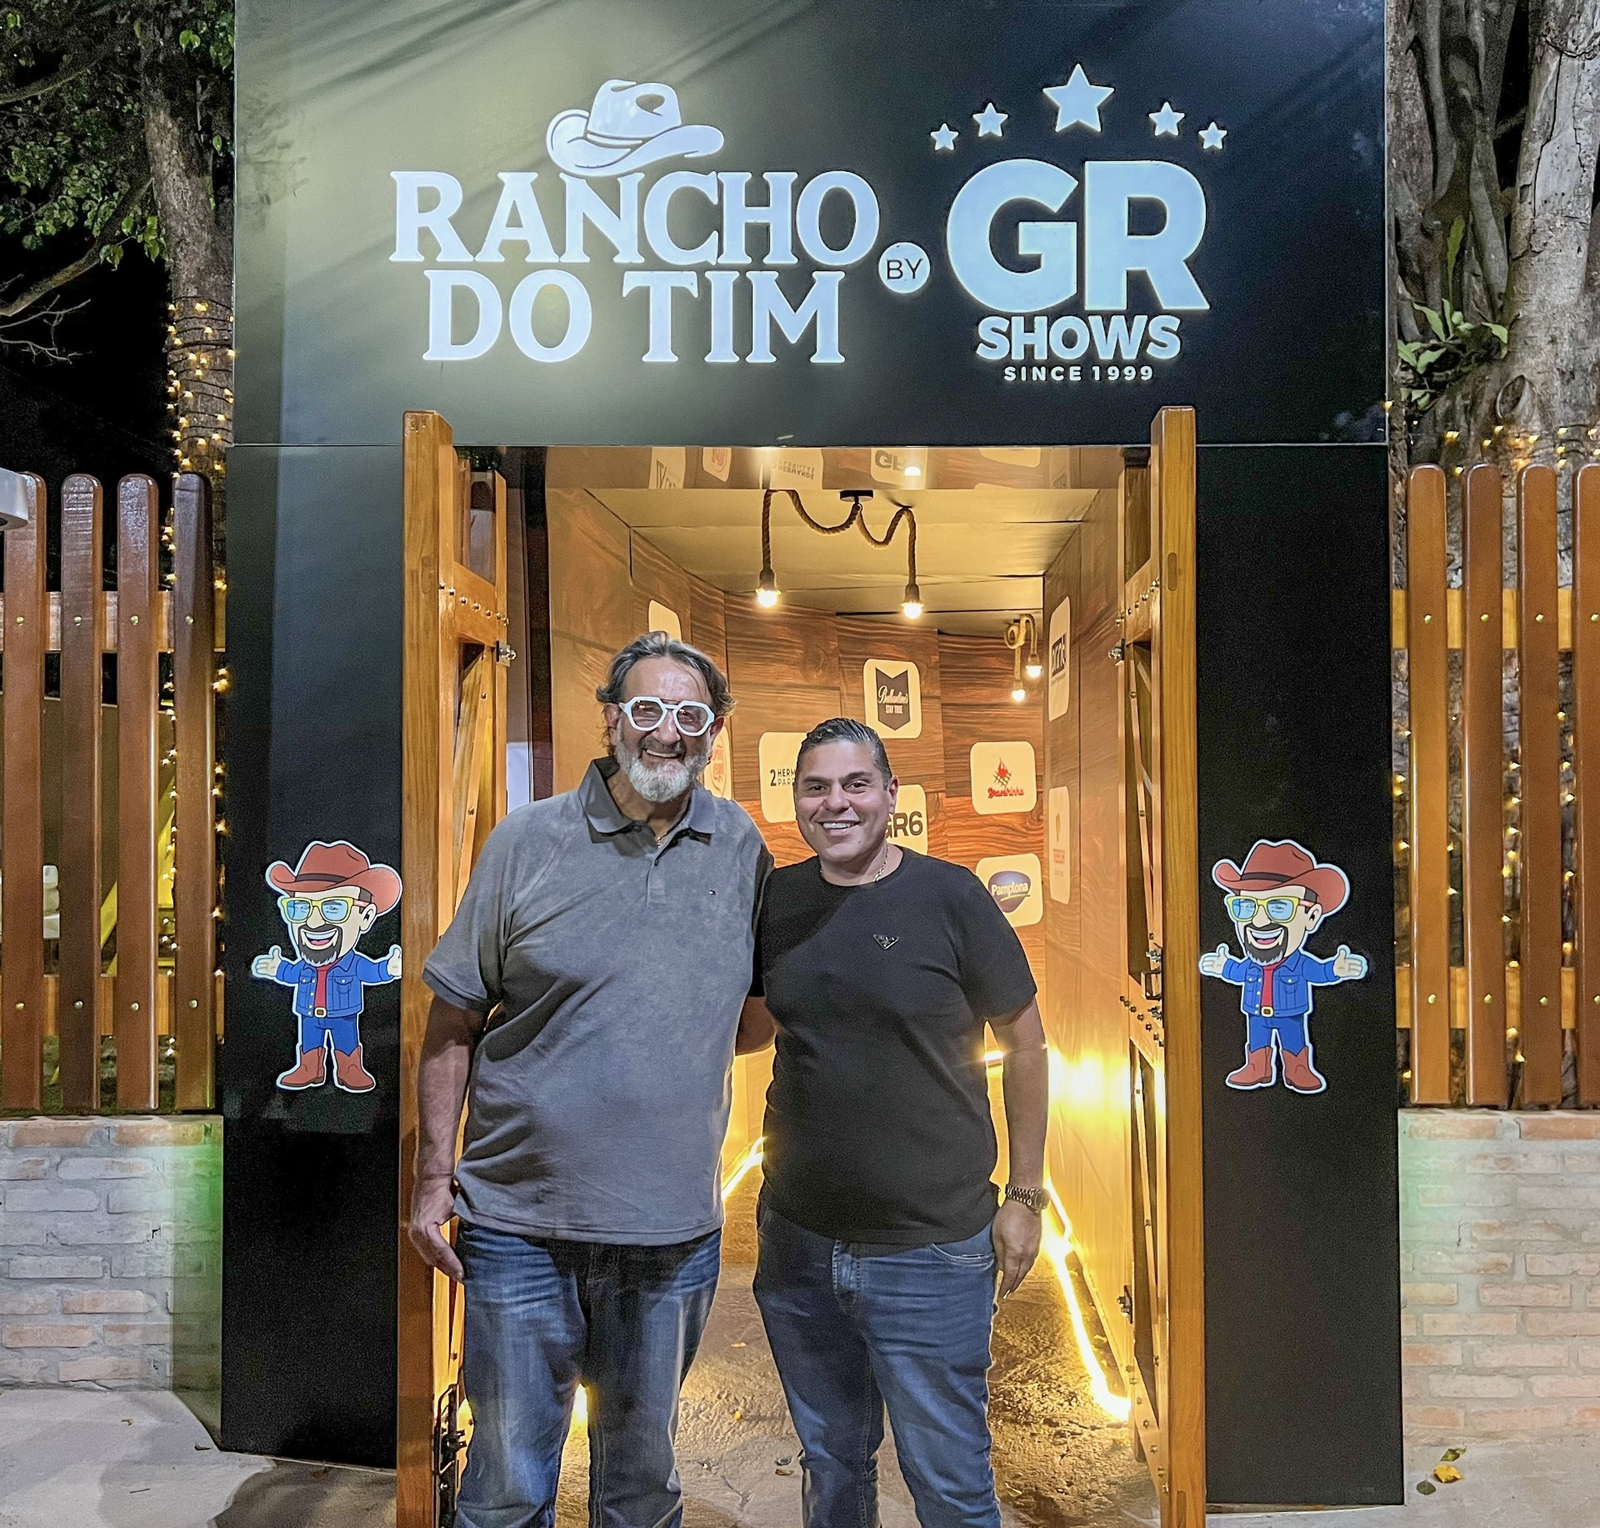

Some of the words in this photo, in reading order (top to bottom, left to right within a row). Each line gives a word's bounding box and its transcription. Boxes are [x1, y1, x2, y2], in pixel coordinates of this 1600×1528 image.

[389, 170, 880, 266] RANCHO
[946, 158, 1210, 313] GR
[886, 258, 924, 280] BY
[423, 269, 593, 362] DO
[622, 270, 846, 363] TIM
[976, 315, 1181, 360] SHOWS
[1003, 365, 1082, 381] SINCE
[1091, 365, 1153, 381] 1999
[991, 882, 1029, 897] Pamplona
